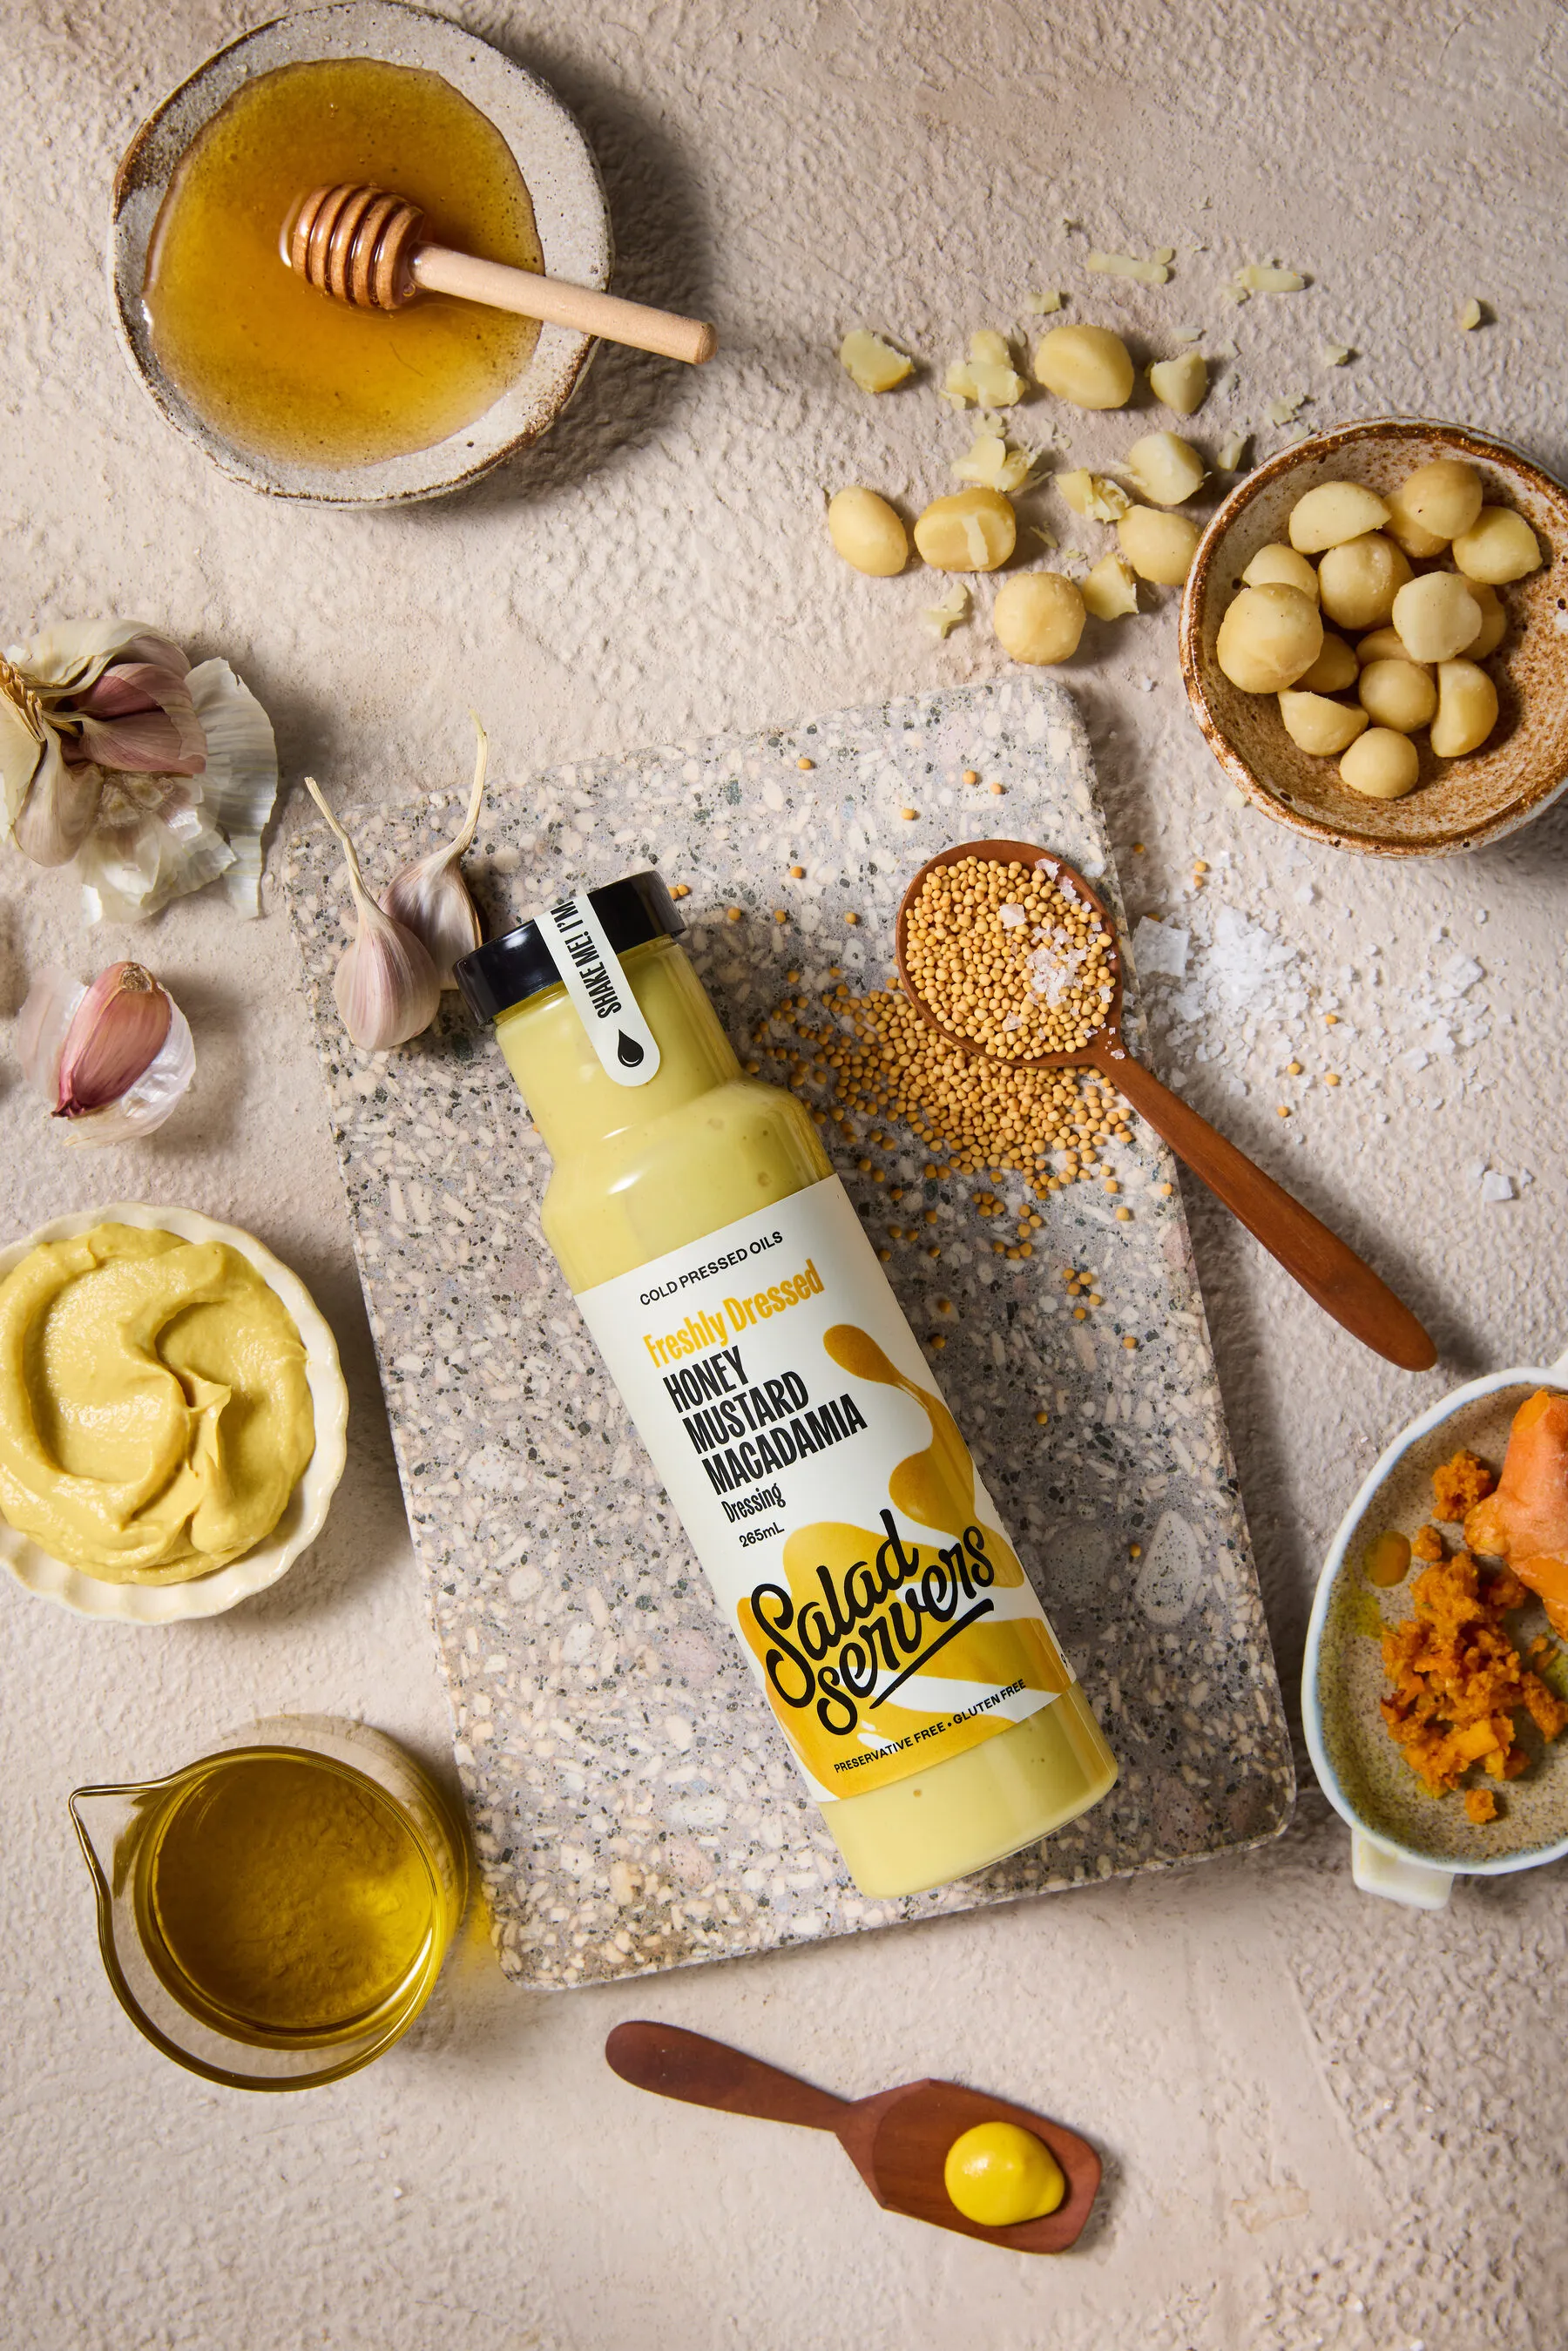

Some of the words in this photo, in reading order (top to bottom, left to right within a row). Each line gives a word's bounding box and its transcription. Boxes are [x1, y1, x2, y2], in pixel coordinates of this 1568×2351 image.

[551, 901, 584, 933] I'M
[564, 930, 600, 968] ME!
[579, 961, 622, 1018] SHAKE
[639, 1281, 678, 1306] COLD
[679, 1248, 748, 1288] PRESSED
[749, 1231, 784, 1256] OILS
[642, 1310, 729, 1368] Freshly
[722, 1258, 825, 1333] Dressed
[663, 1345, 749, 1414] HONEY
[682, 1370, 809, 1455] MUSTARD
[701, 1394, 868, 1496] MACADAMIA
[721, 1483, 787, 1523] Dressing
[739, 1521, 785, 1548] 265mL
[750, 1509, 919, 1709] Salad
[816, 1525, 995, 1736] servers
[834, 1736, 914, 1773] PRESERVATIVE
[914, 1721, 947, 1744] FREE
[952, 1694, 1001, 1725] GLUTEN
[999, 1679, 1026, 1702] FREE
